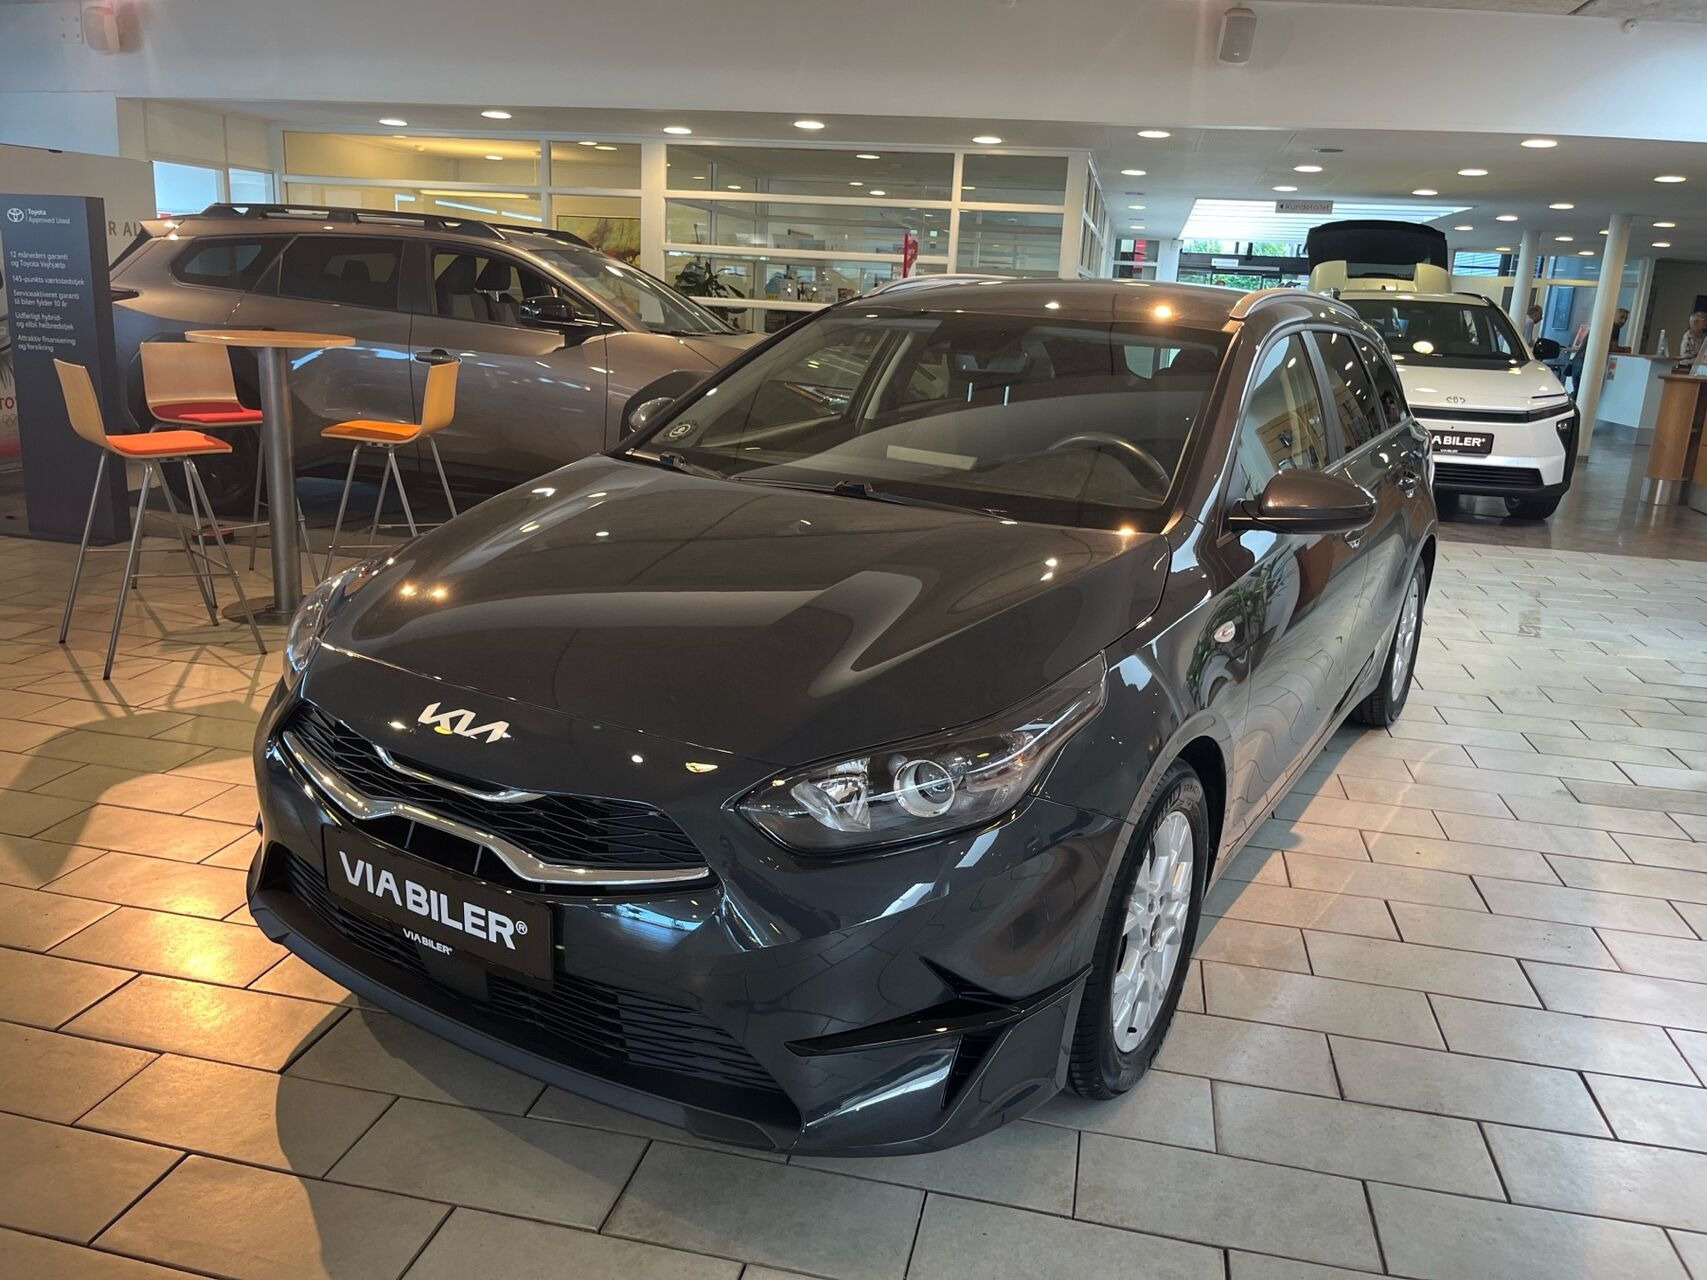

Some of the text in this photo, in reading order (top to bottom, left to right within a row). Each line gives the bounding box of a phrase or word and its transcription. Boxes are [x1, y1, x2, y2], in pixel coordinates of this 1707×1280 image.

[28, 208, 47, 217] Toyota
[29, 216, 55, 224] Approved
[10, 250, 17, 258] 12
[47, 253, 69, 261] garanti
[10, 260, 19, 268] og
[20, 259, 40, 269] Toyota
[59, 292, 80, 301] garanti
[21, 298, 36, 306] bilen
[36, 299, 53, 308] fylder
[54, 299, 61, 307] 10
[61, 300, 68, 308] år
[16, 321, 25, 329] og
[17, 334, 76, 347] Attraktiv finansiering
[18, 343, 54, 353] og forsikring
[418, 702, 510, 744] KIA
